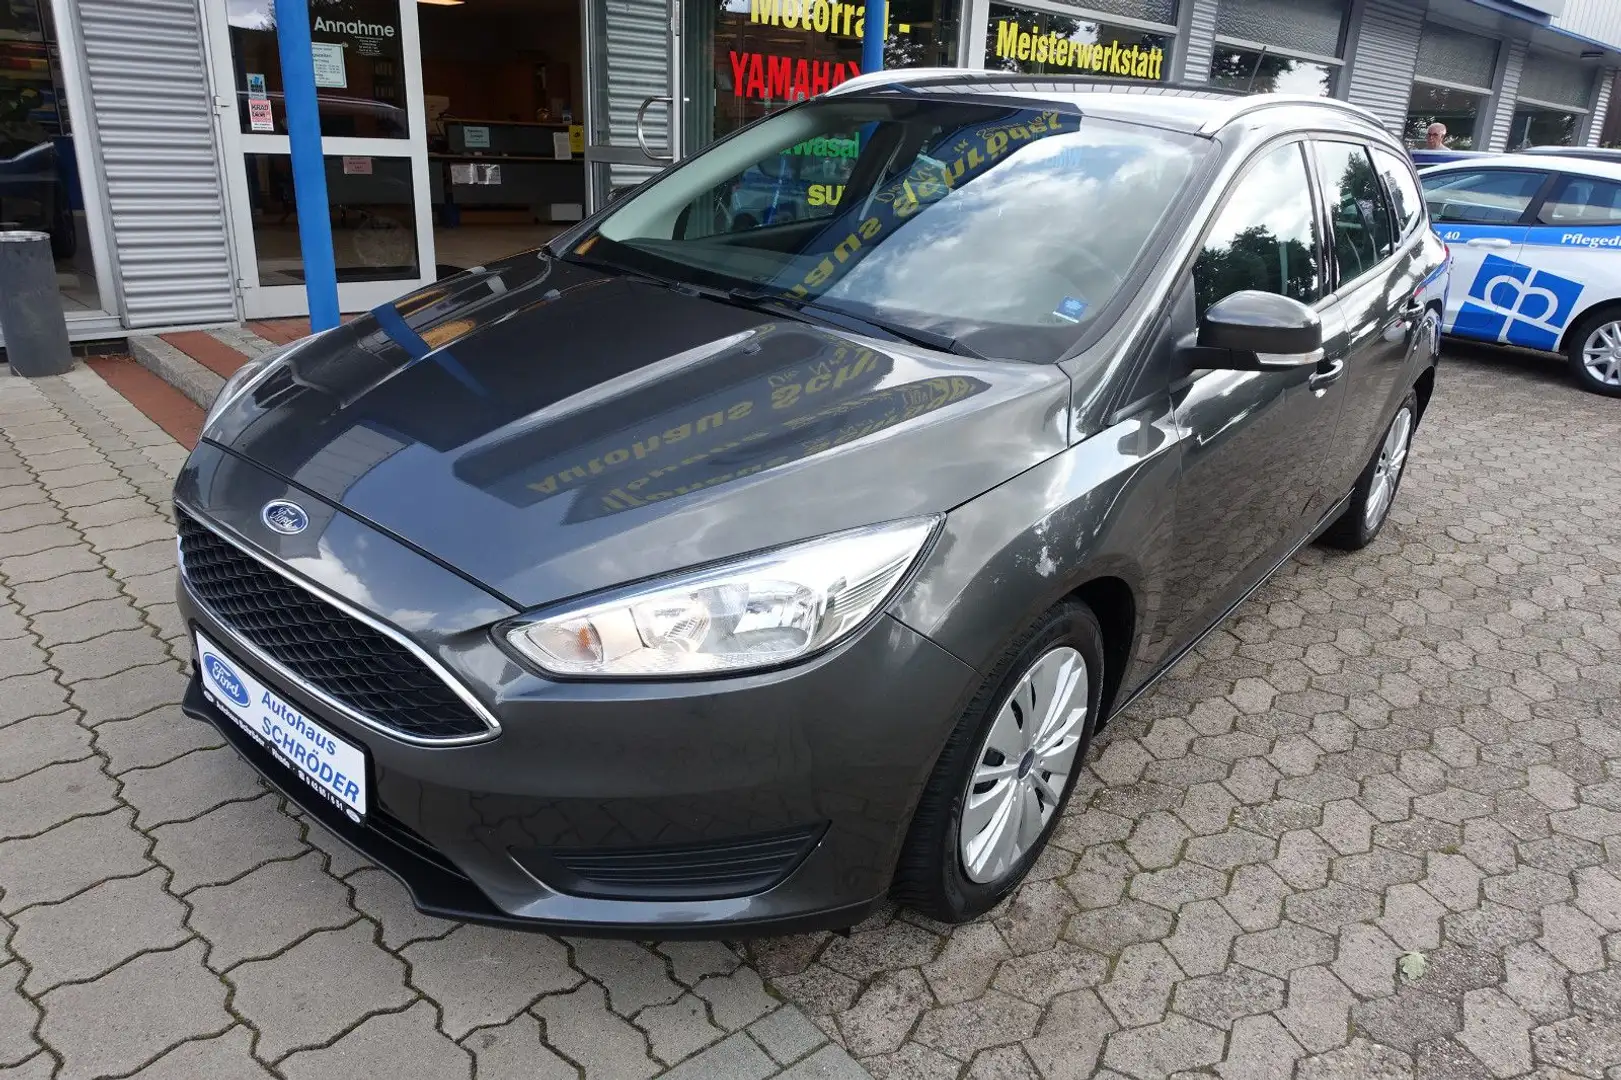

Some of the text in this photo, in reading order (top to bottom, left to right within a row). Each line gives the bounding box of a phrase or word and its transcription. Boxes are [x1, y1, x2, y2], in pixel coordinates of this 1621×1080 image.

[314, 16, 395, 37] Annahme
[751, 0, 889, 40] Motorra
[996, 20, 1163, 80] Meisterwerkstatt
[212, 661, 240, 697] Ford
[261, 691, 337, 756] Autohaus
[262, 716, 360, 804] SCHRÖDER
